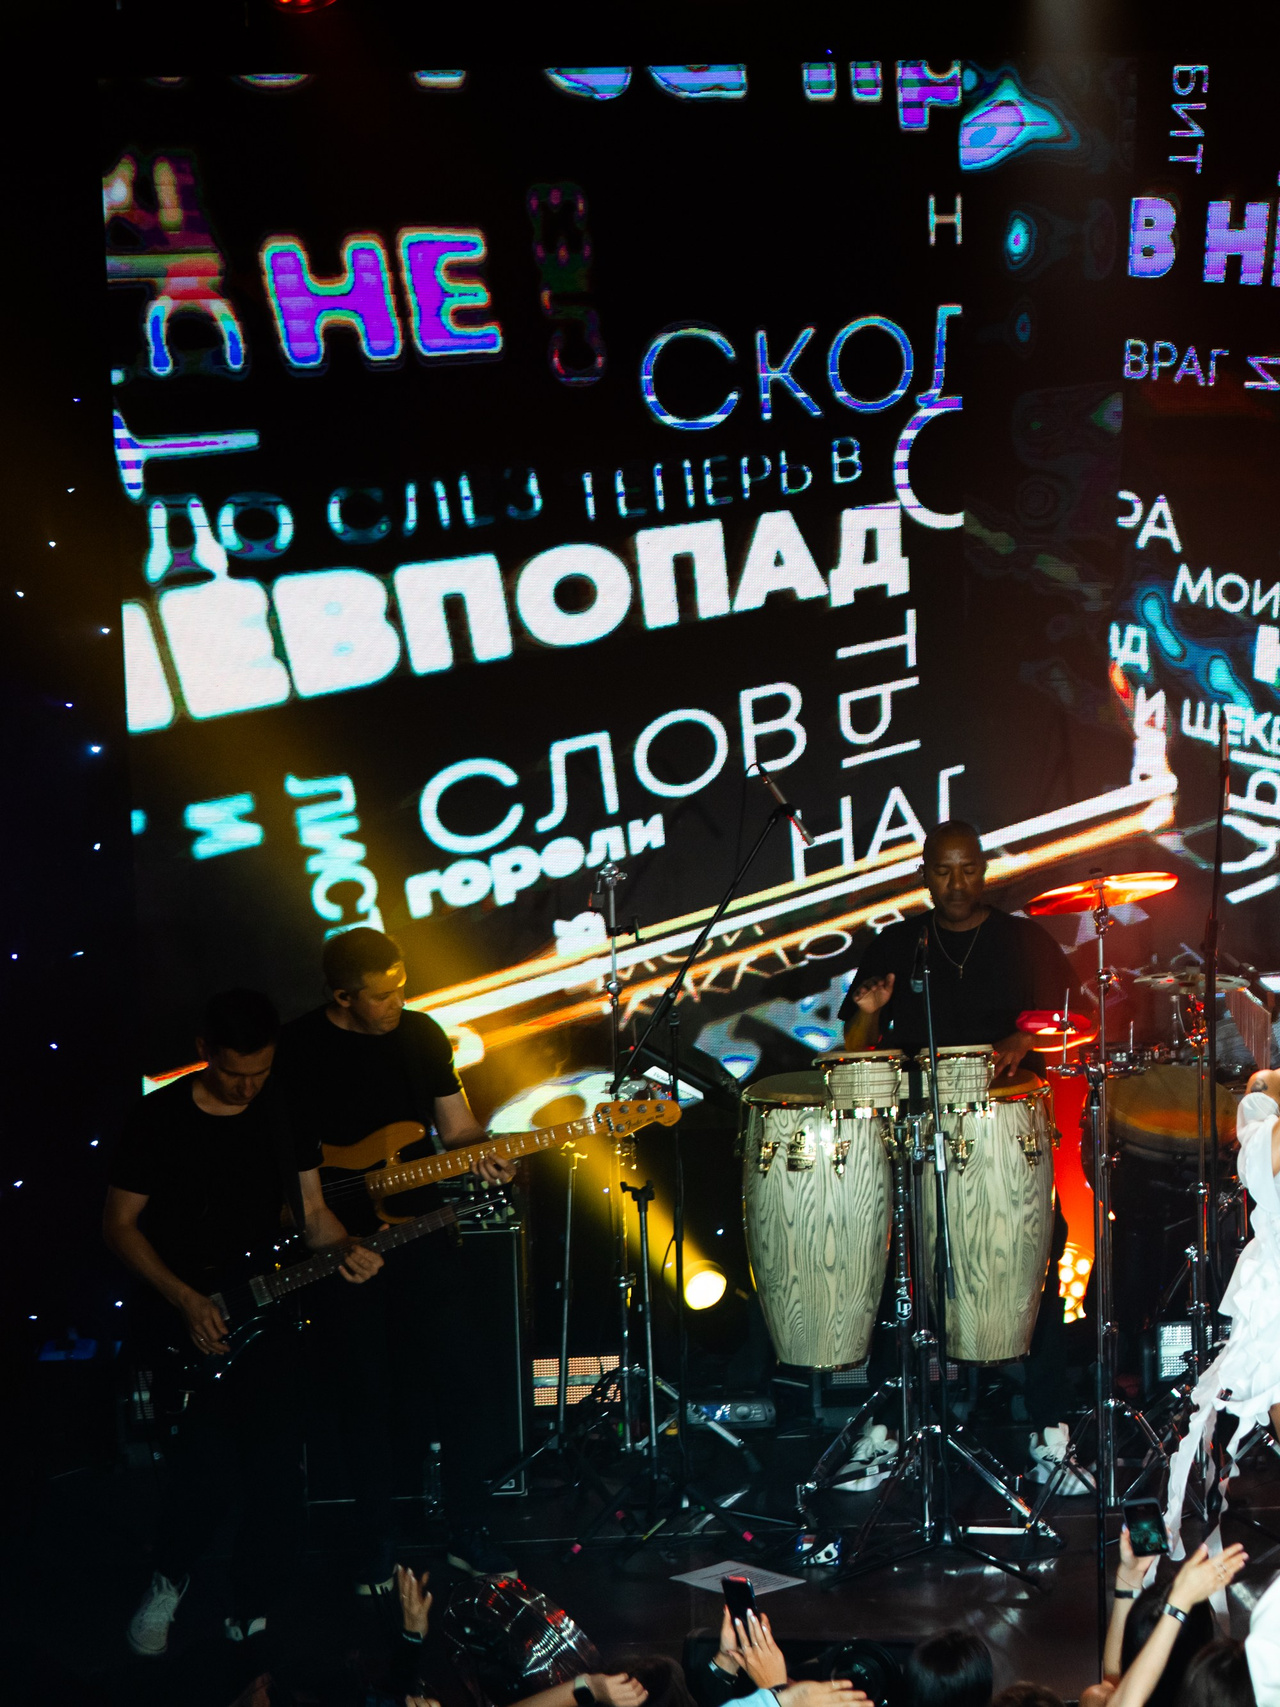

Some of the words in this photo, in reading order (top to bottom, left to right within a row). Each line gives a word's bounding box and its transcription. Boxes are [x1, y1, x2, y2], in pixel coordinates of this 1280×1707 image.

[1168, 65, 1209, 175] БИТ
[1127, 196, 1178, 278] В
[260, 226, 503, 370] НЕ
[1122, 338, 1229, 387] ВРАГ
[831, 437, 863, 485] В
[836, 608, 922, 769] ТЫ
[419, 681, 807, 854] СЛОВ
